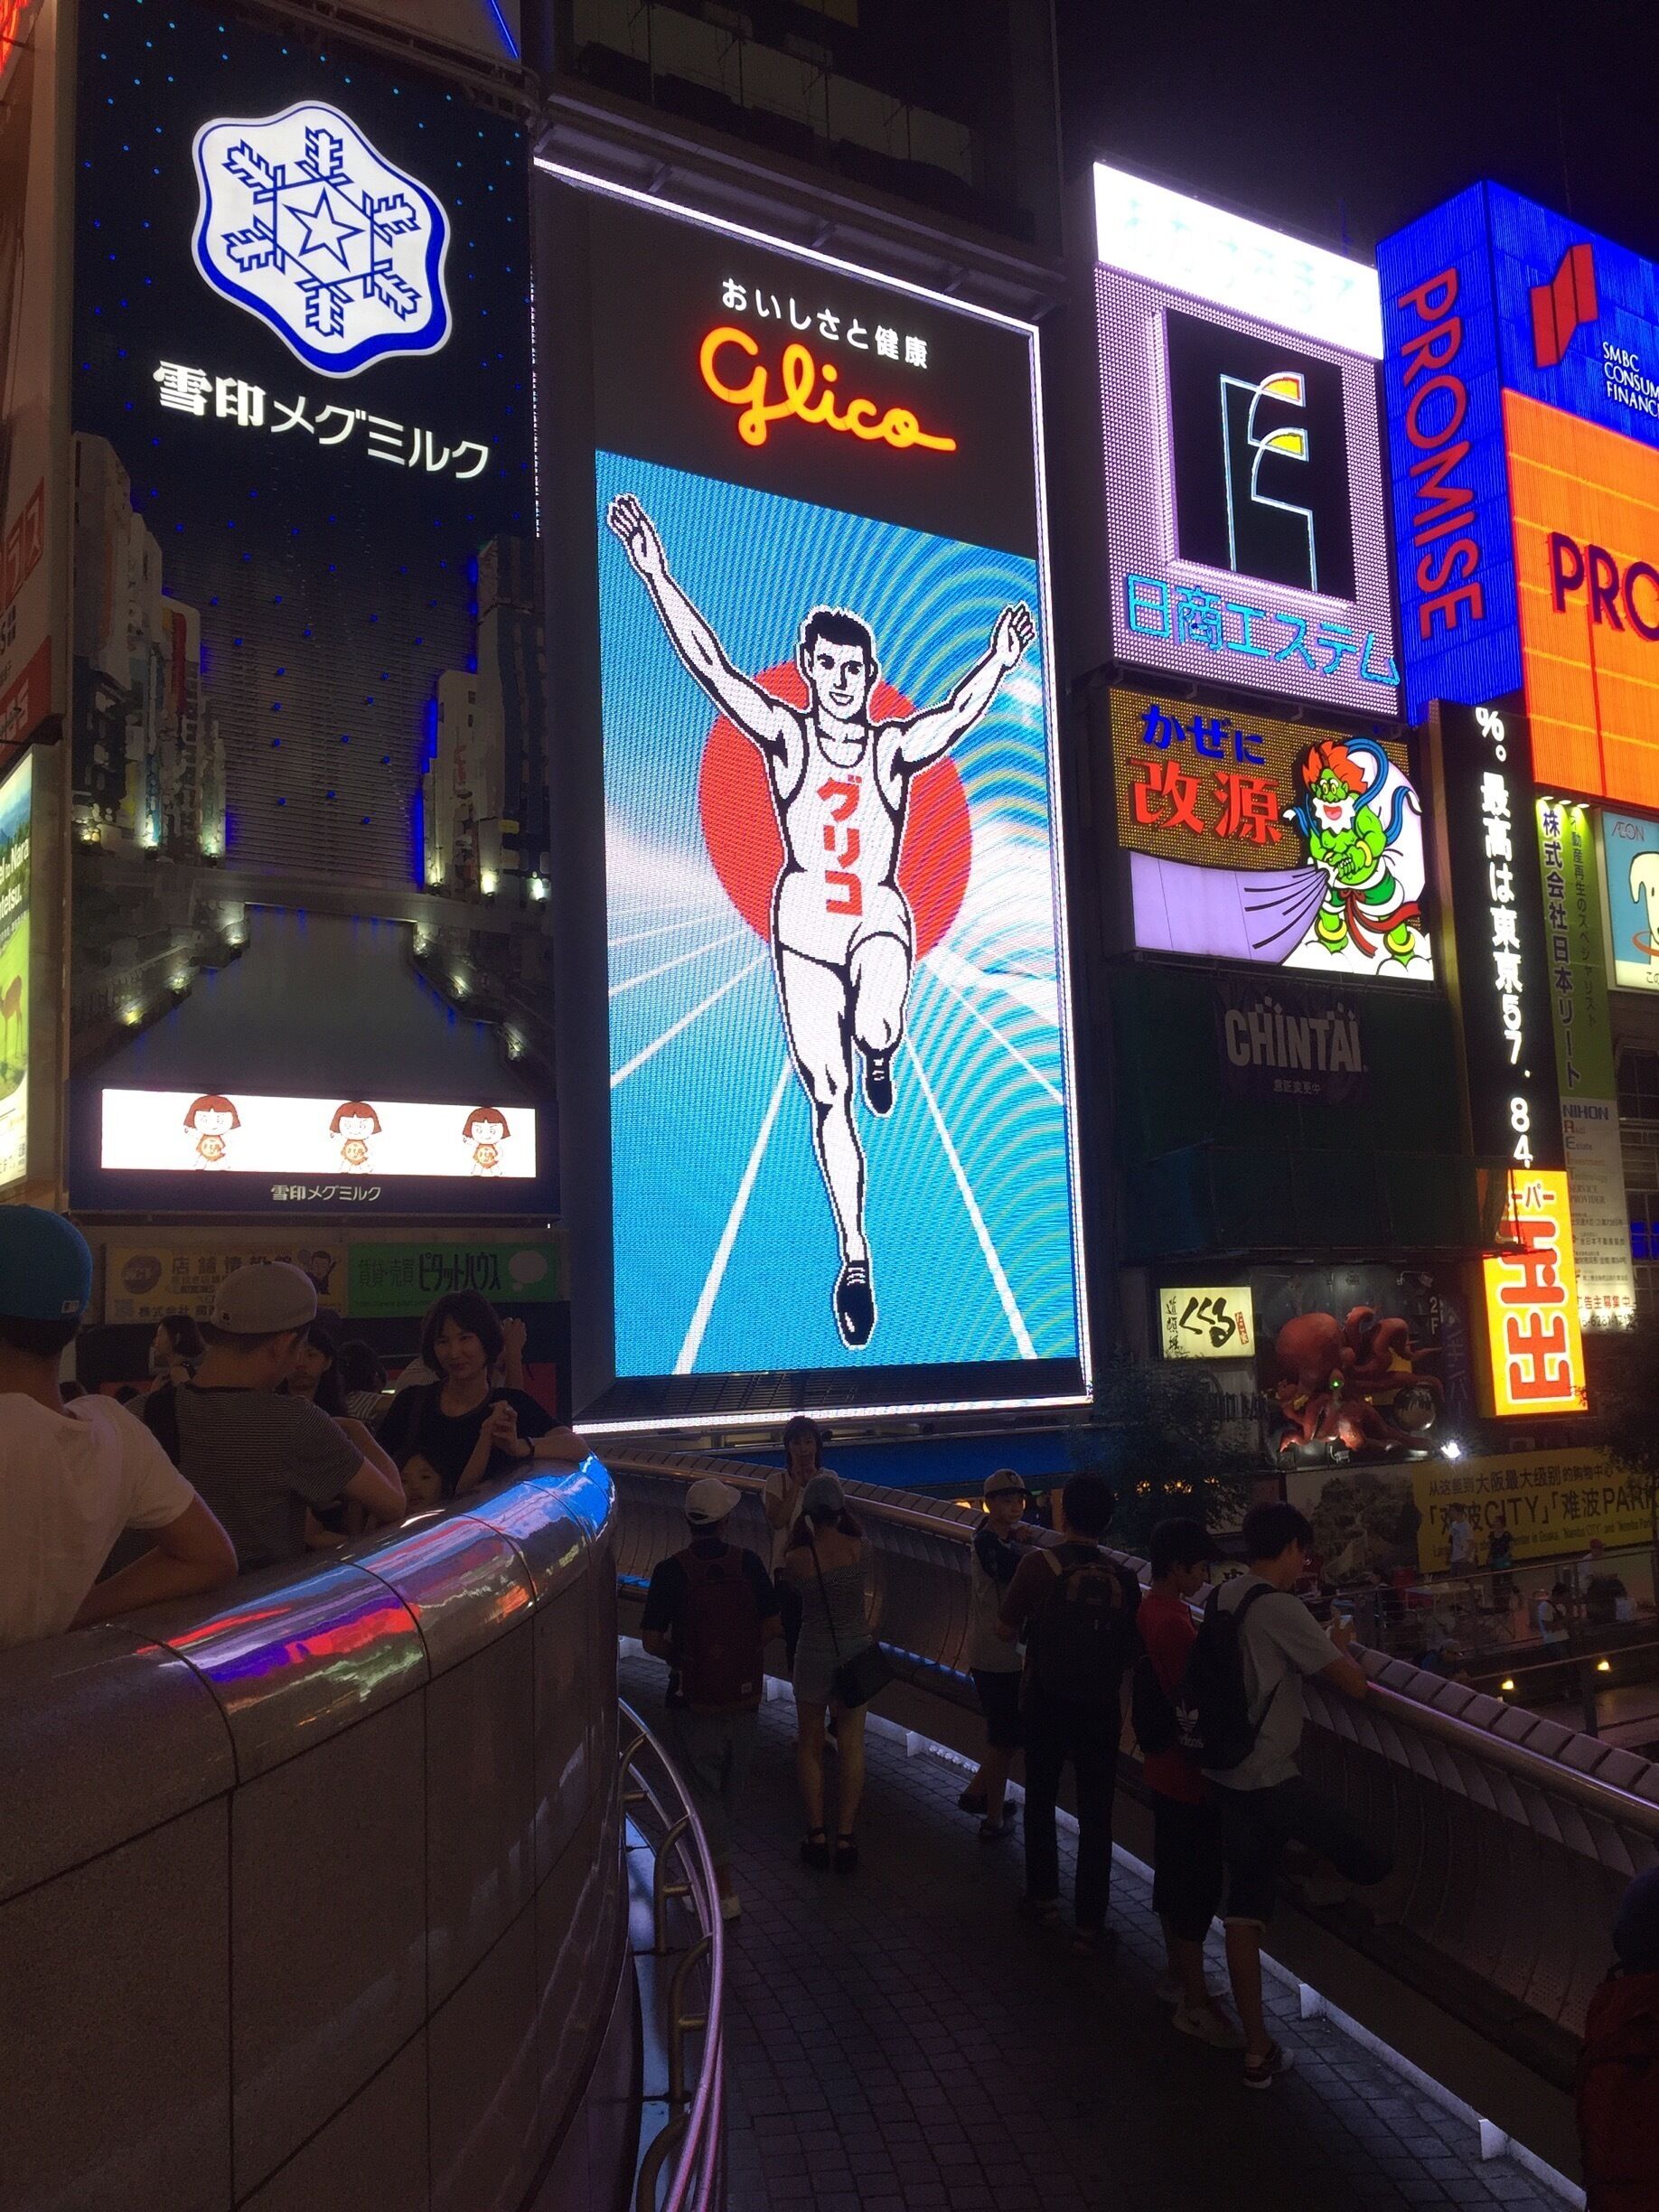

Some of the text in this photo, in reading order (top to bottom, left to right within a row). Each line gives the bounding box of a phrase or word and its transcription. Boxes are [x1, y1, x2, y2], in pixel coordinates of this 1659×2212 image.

[721, 277, 928, 370] おいしさと健康
[1602, 341, 1640, 372] SMBC
[153, 360, 489, 479] 雪印メグミルク
[698, 325, 957, 452] Glico
[1607, 380, 1659, 419] FINANC
[1399, 267, 1484, 640] PROMISE
[1126, 573, 1401, 687] 日商エステム
[1141, 705, 1267, 765] かぜに
[1129, 758, 1283, 846] 改源
[816, 773, 863, 916] グリコ
[1543, 811, 1581, 1090] 株式会社日本リート
[1561, 1104, 1609, 1120] NIHON
[270, 1184, 382, 1203] 雪印メグミルク
[1508, 1182, 1555, 1209] ーパー
[418, 1251, 501, 1292] ピタットハウス
[1178, 1297, 1236, 1348] くくる
